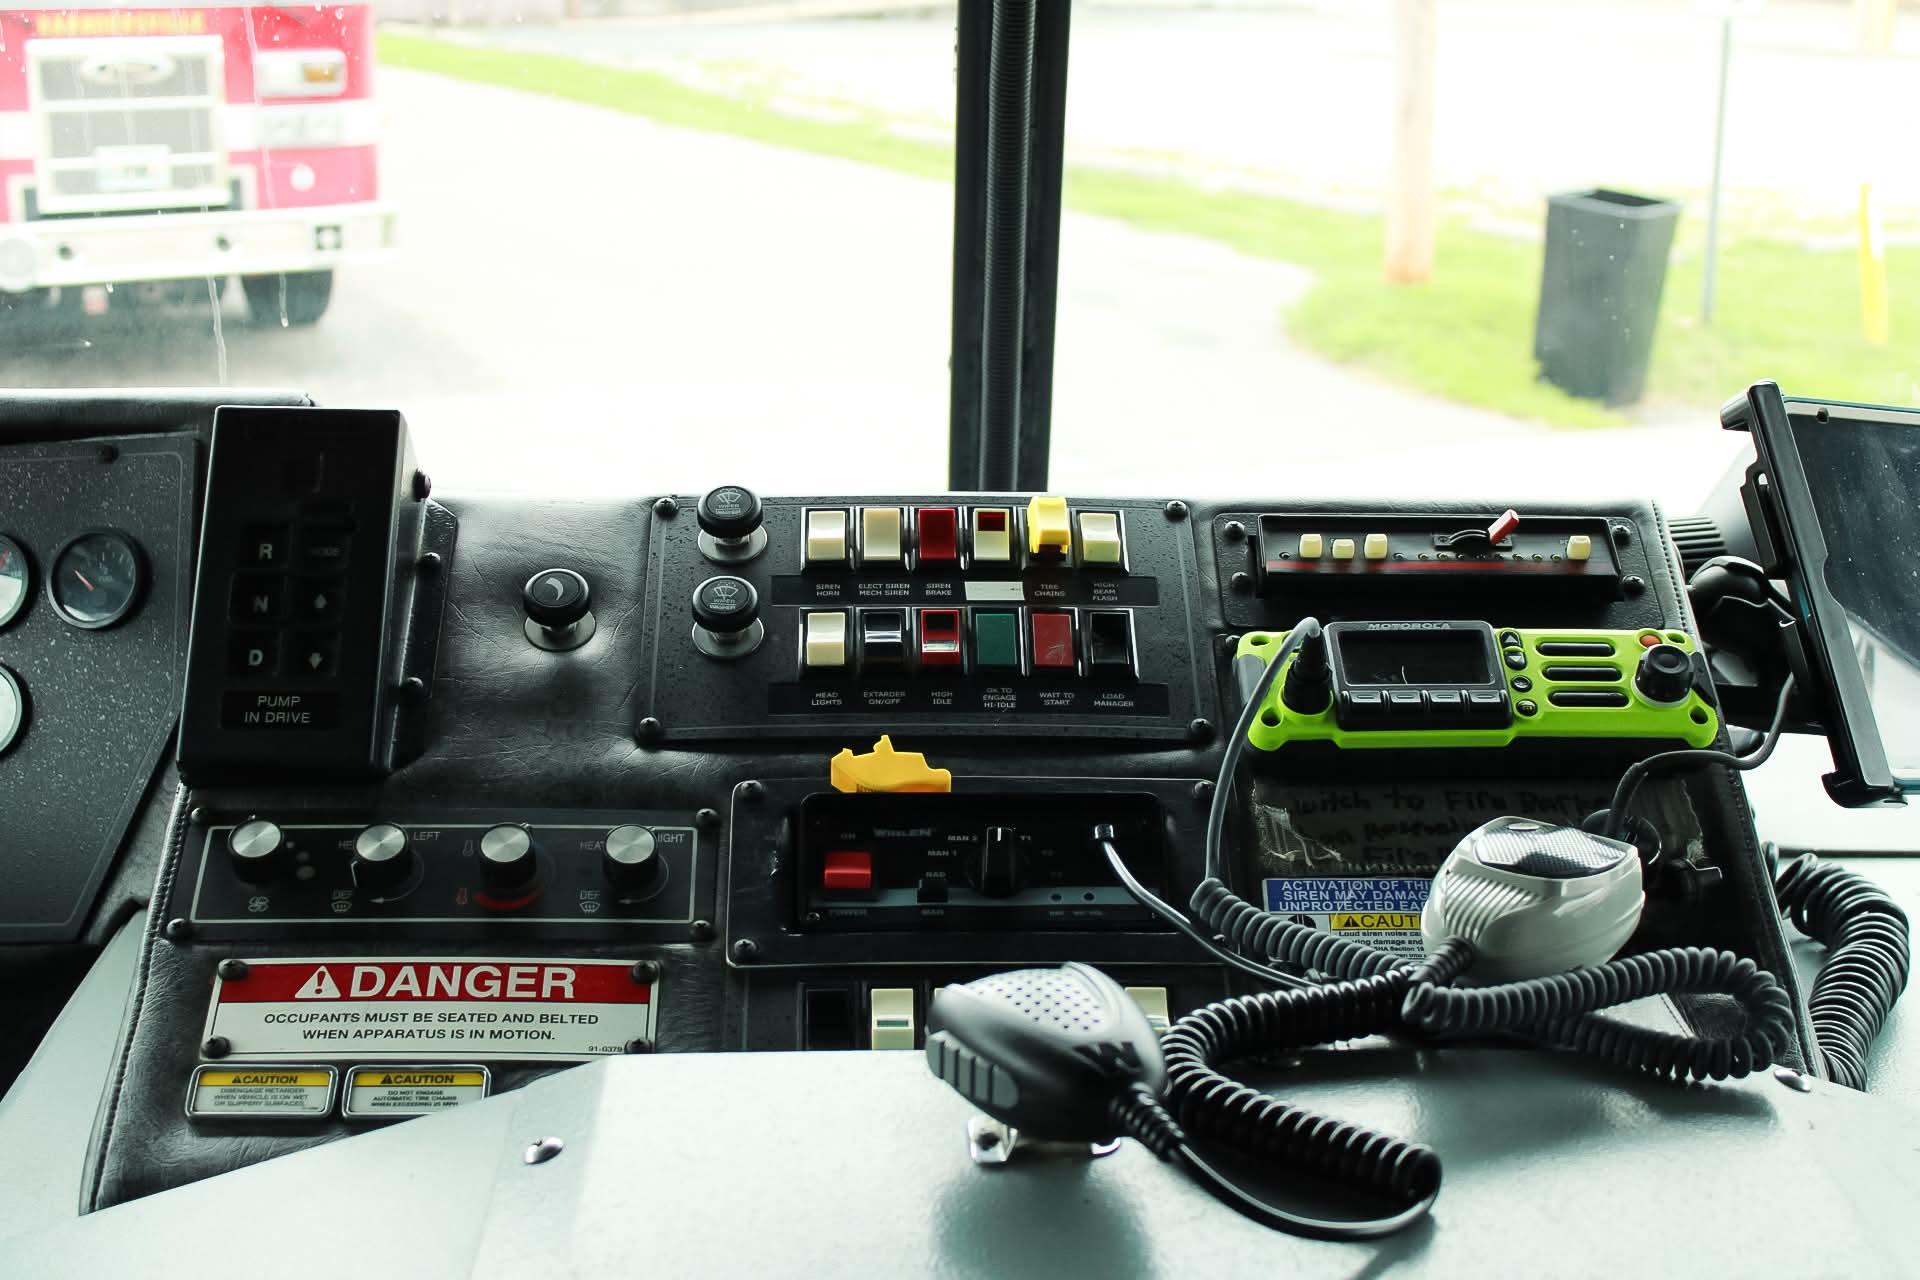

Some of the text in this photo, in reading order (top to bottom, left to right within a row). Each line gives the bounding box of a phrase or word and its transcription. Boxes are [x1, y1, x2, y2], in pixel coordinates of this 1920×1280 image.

[258, 543, 273, 560] R
[254, 595, 269, 612] N
[1368, 622, 1450, 631] MOTOROLA
[248, 648, 264, 666] D
[257, 696, 301, 707] PUMP
[1102, 692, 1125, 700] LOAD
[244, 711, 312, 724] IN DRIVE
[412, 831, 441, 841] LEFT
[338, 840, 353, 849] HE
[1282, 880, 1430, 891] ACTIVATION OF THI
[580, 890, 601, 900] DEF
[1283, 890, 1428, 901] SIREN MAY DAMAG
[1279, 900, 1394, 912] UNPROTECTED
[1361, 914, 1417, 928] CAUT
[1372, 938, 1406, 946] damage
[350, 965, 576, 998] DANGER
[264, 1012, 599, 1024] OCCUPANTS MUST BE SEATED AND BELTED
[302, 1029, 555, 1040] WHEN APPARATUS IS IN MOTION.
[242, 1075, 298, 1084] CAUTION
[393, 1075, 456, 1084] CAUTION
